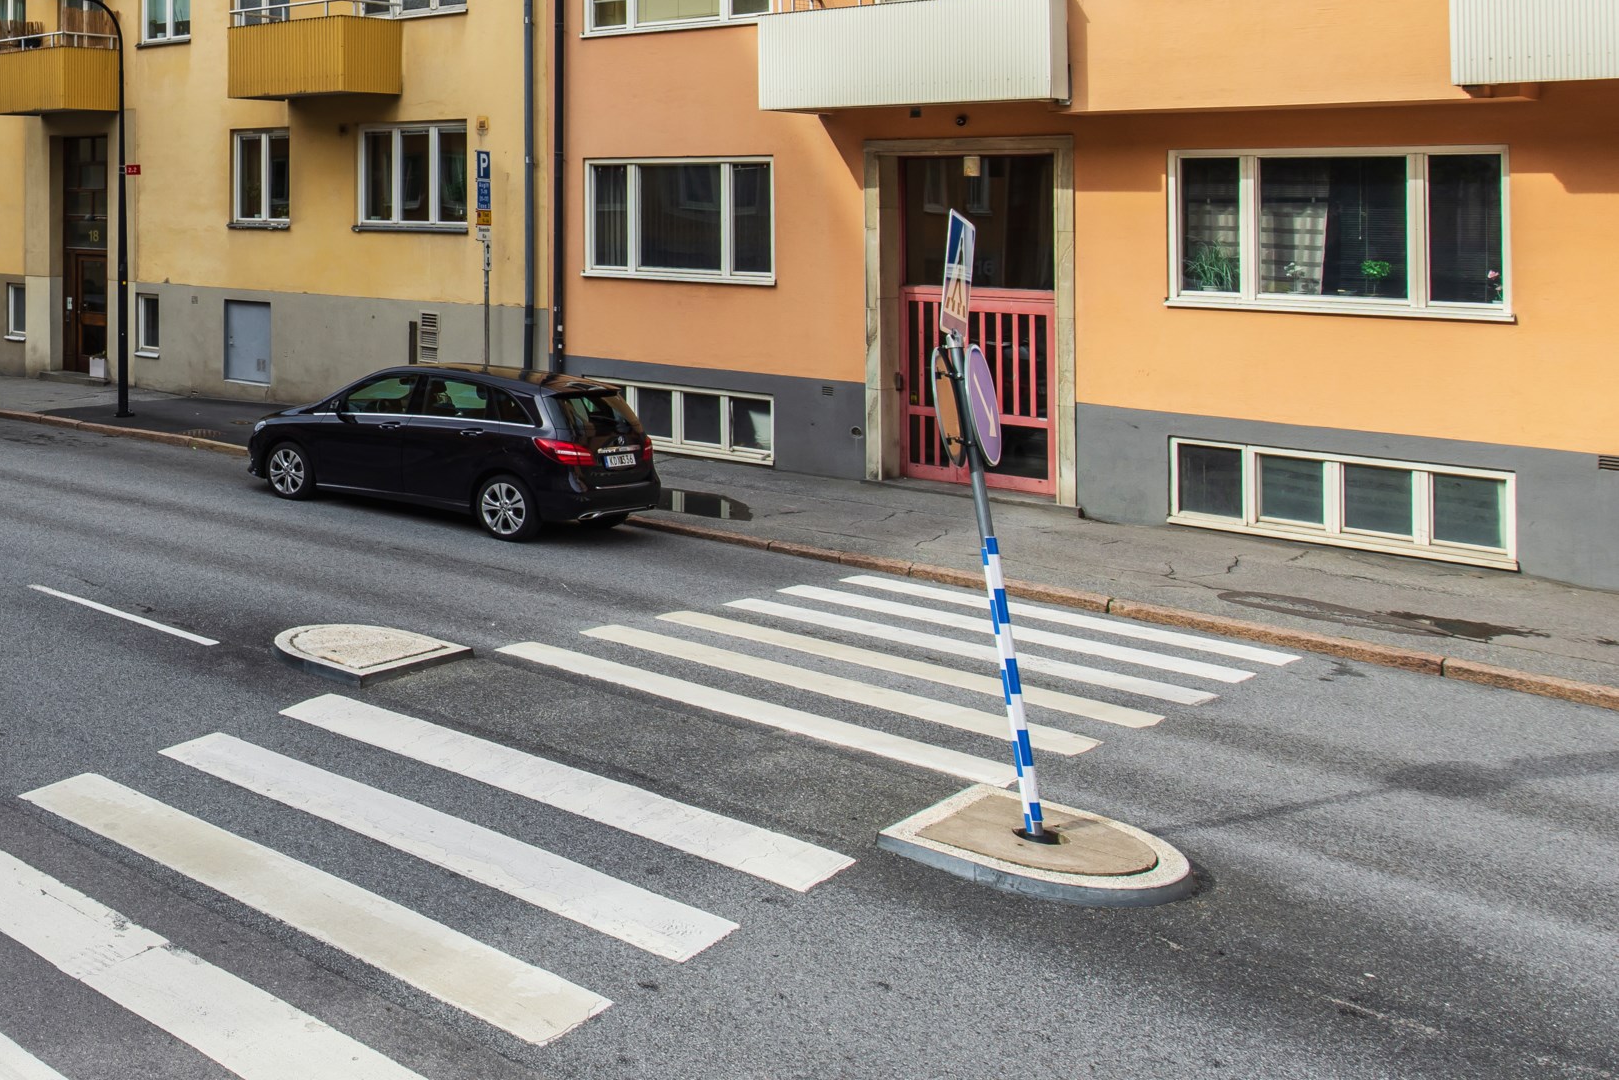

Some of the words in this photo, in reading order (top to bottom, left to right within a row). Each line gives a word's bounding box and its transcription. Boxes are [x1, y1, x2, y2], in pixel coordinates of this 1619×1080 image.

[480, 153, 489, 177] P
[89, 230, 99, 241] 18
[977, 260, 995, 276] 16
